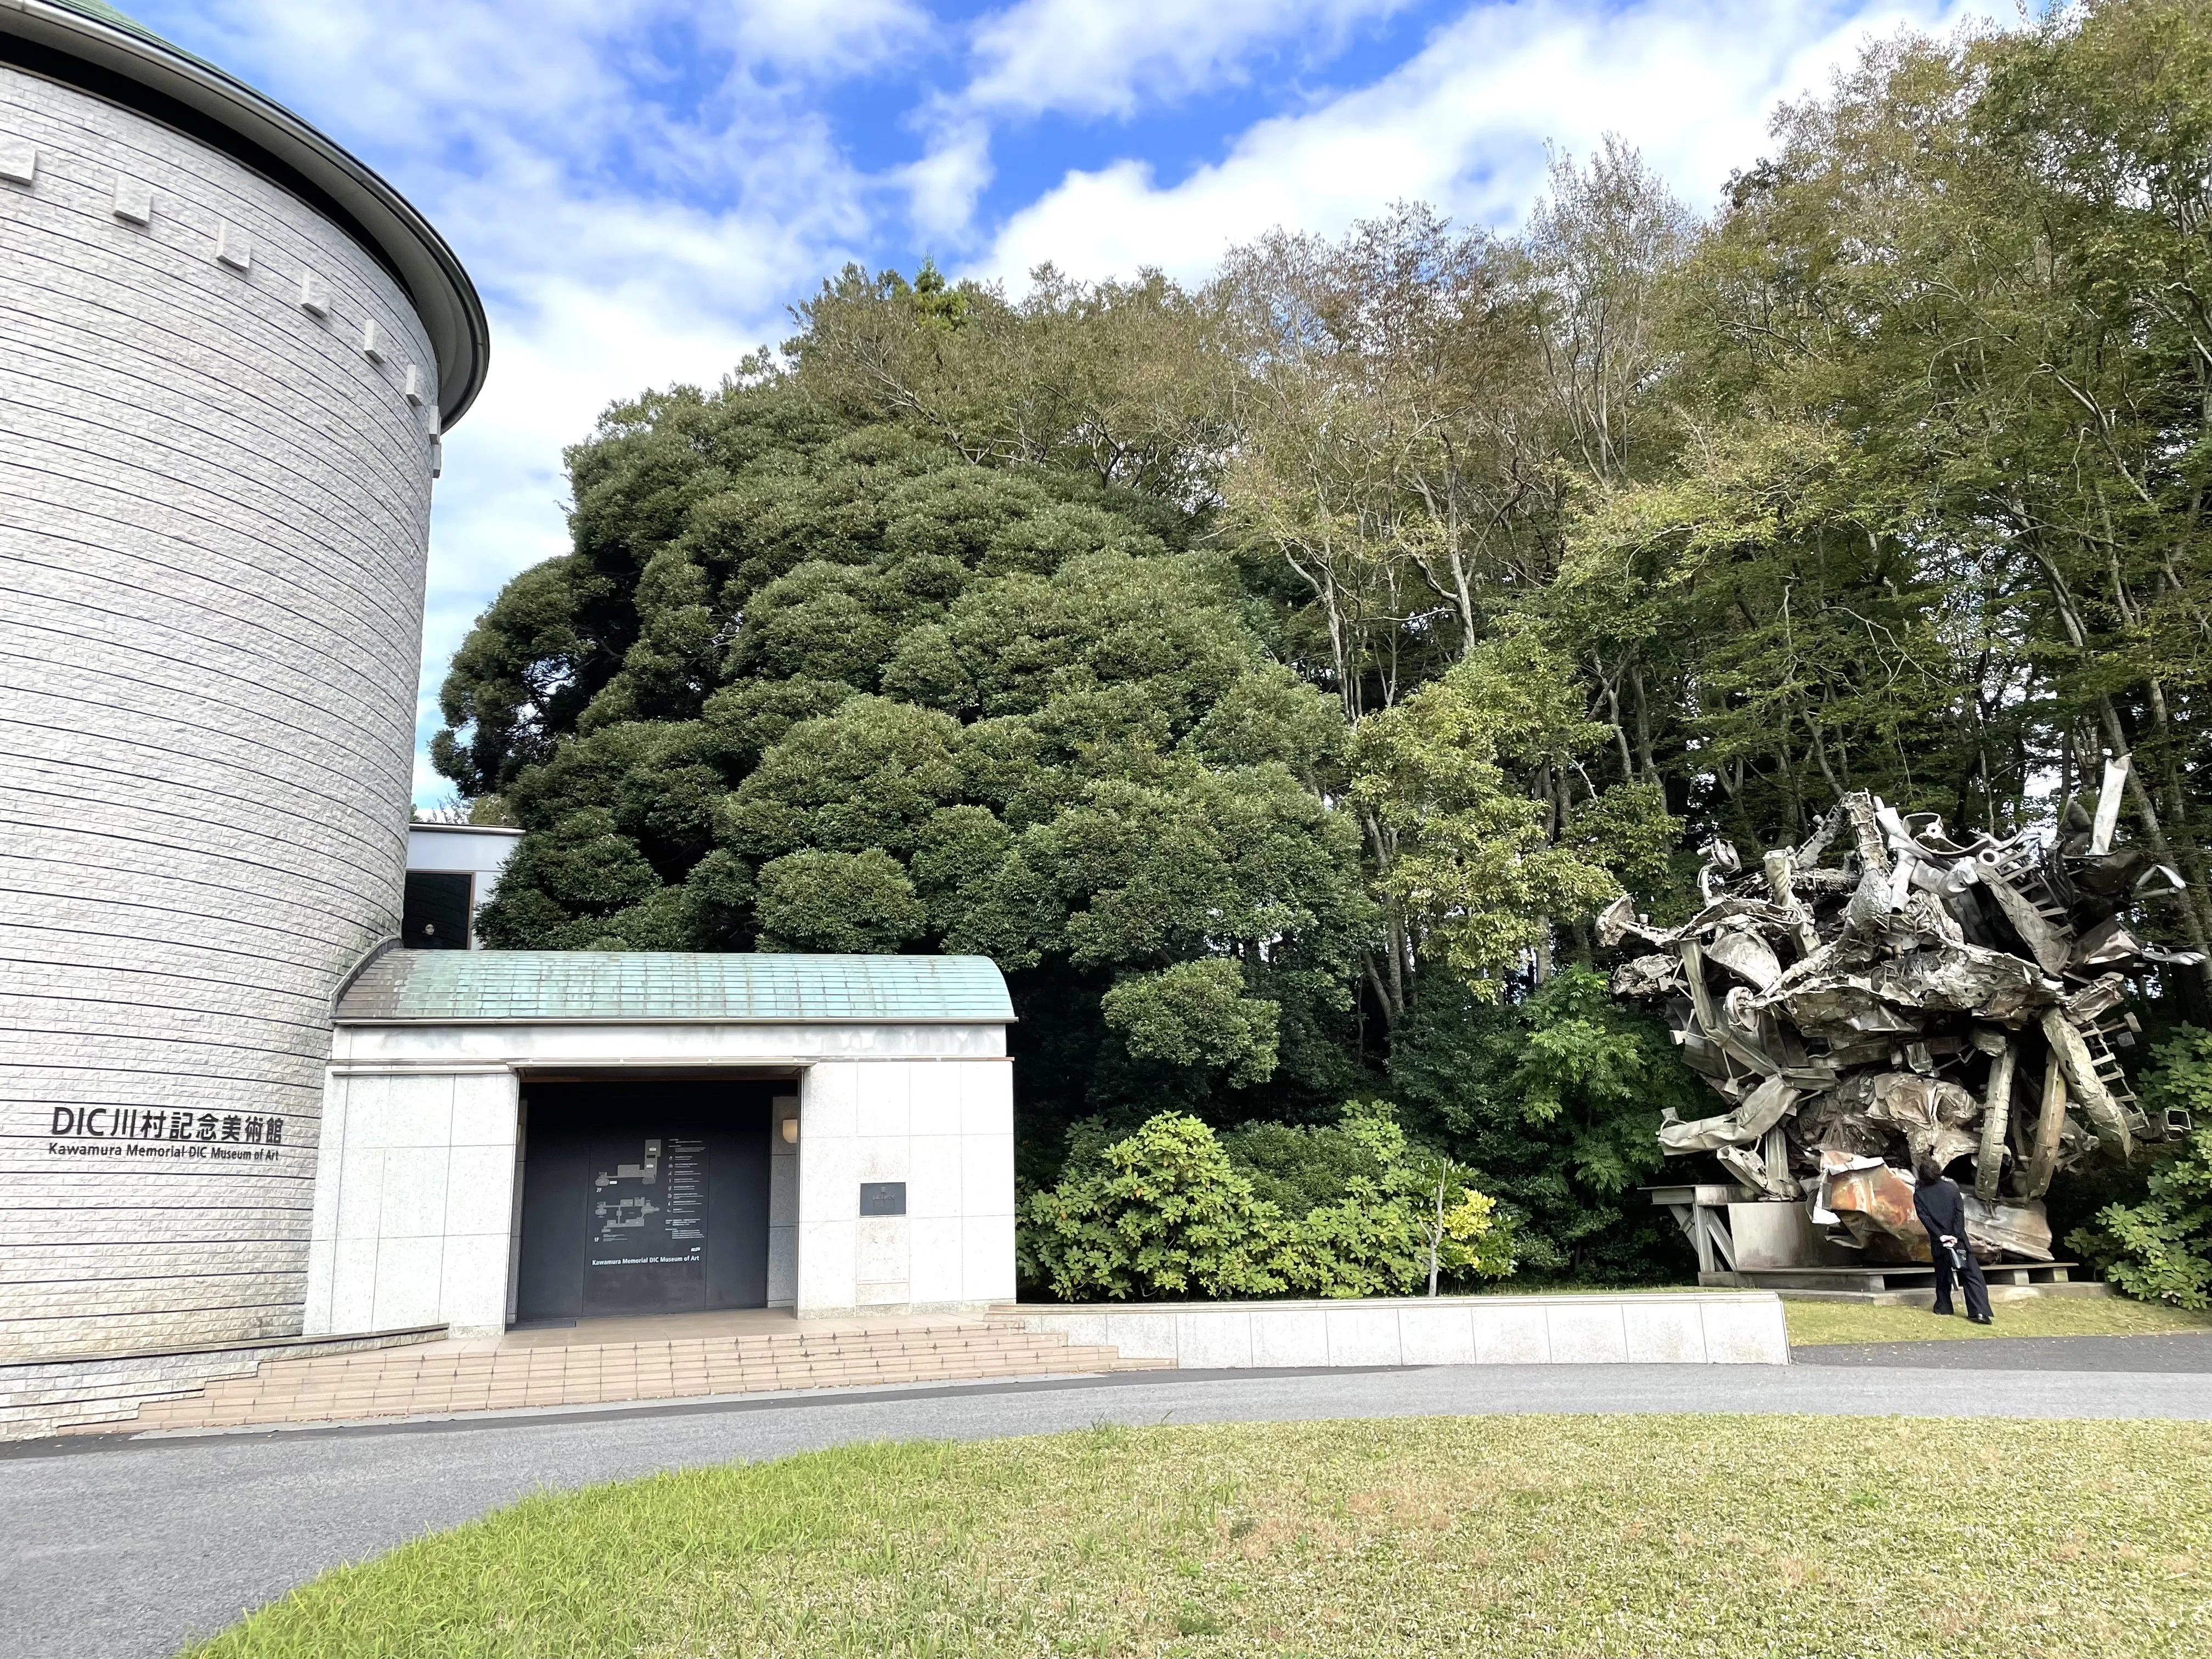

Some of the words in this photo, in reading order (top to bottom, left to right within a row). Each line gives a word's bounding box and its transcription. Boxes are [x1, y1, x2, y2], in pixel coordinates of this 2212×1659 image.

[52, 1107, 284, 1143] DIC川村記念美術館
[48, 1142, 122, 1156] Kawamura
[126, 1144, 185, 1158] Memorial
[189, 1146, 207, 1158] DIC
[211, 1147, 252, 1160] Museum
[254, 1148, 264, 1160] of
[265, 1150, 279, 1160] Art
